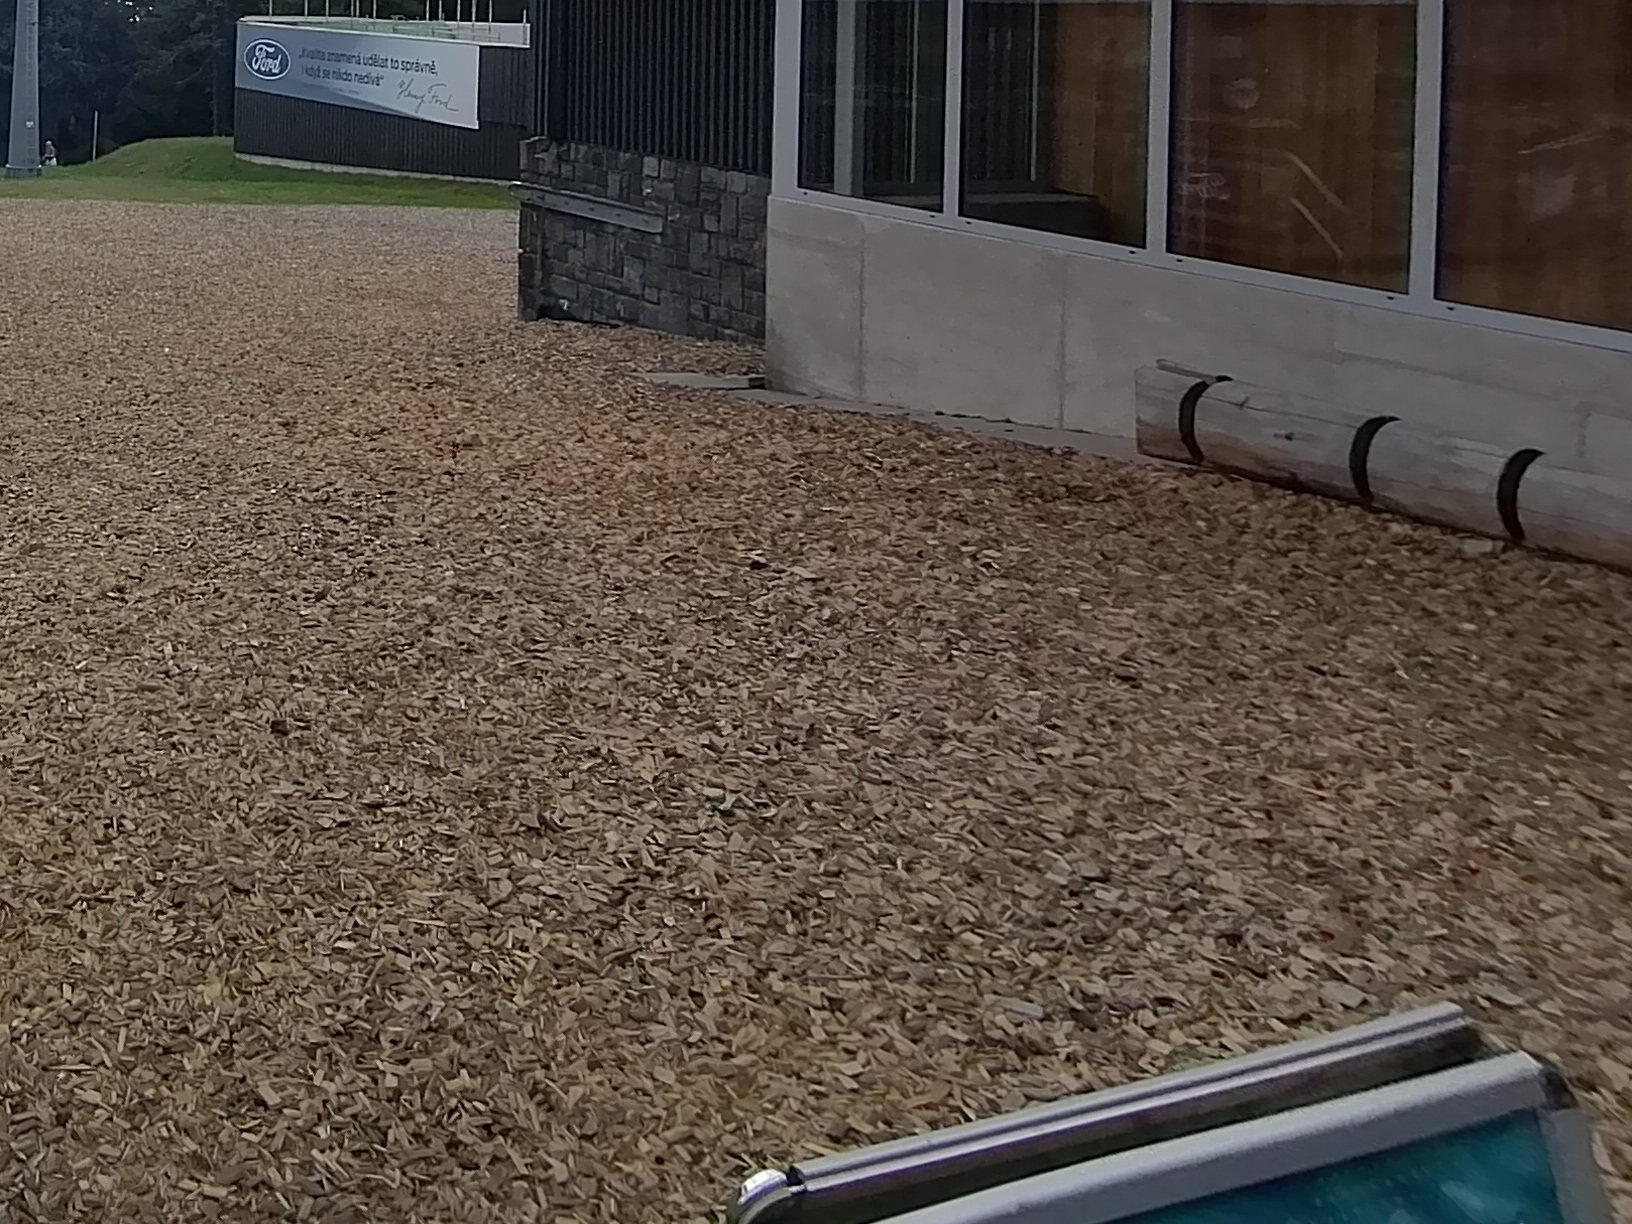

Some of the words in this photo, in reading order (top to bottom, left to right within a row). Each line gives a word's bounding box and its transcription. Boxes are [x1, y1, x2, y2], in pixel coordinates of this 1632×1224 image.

[251, 44, 283, 74] Ford
[326, 51, 362, 65] znamená
[362, 53, 389, 69] udělat
[390, 57, 400, 70] to
[322, 69, 332, 79] se
